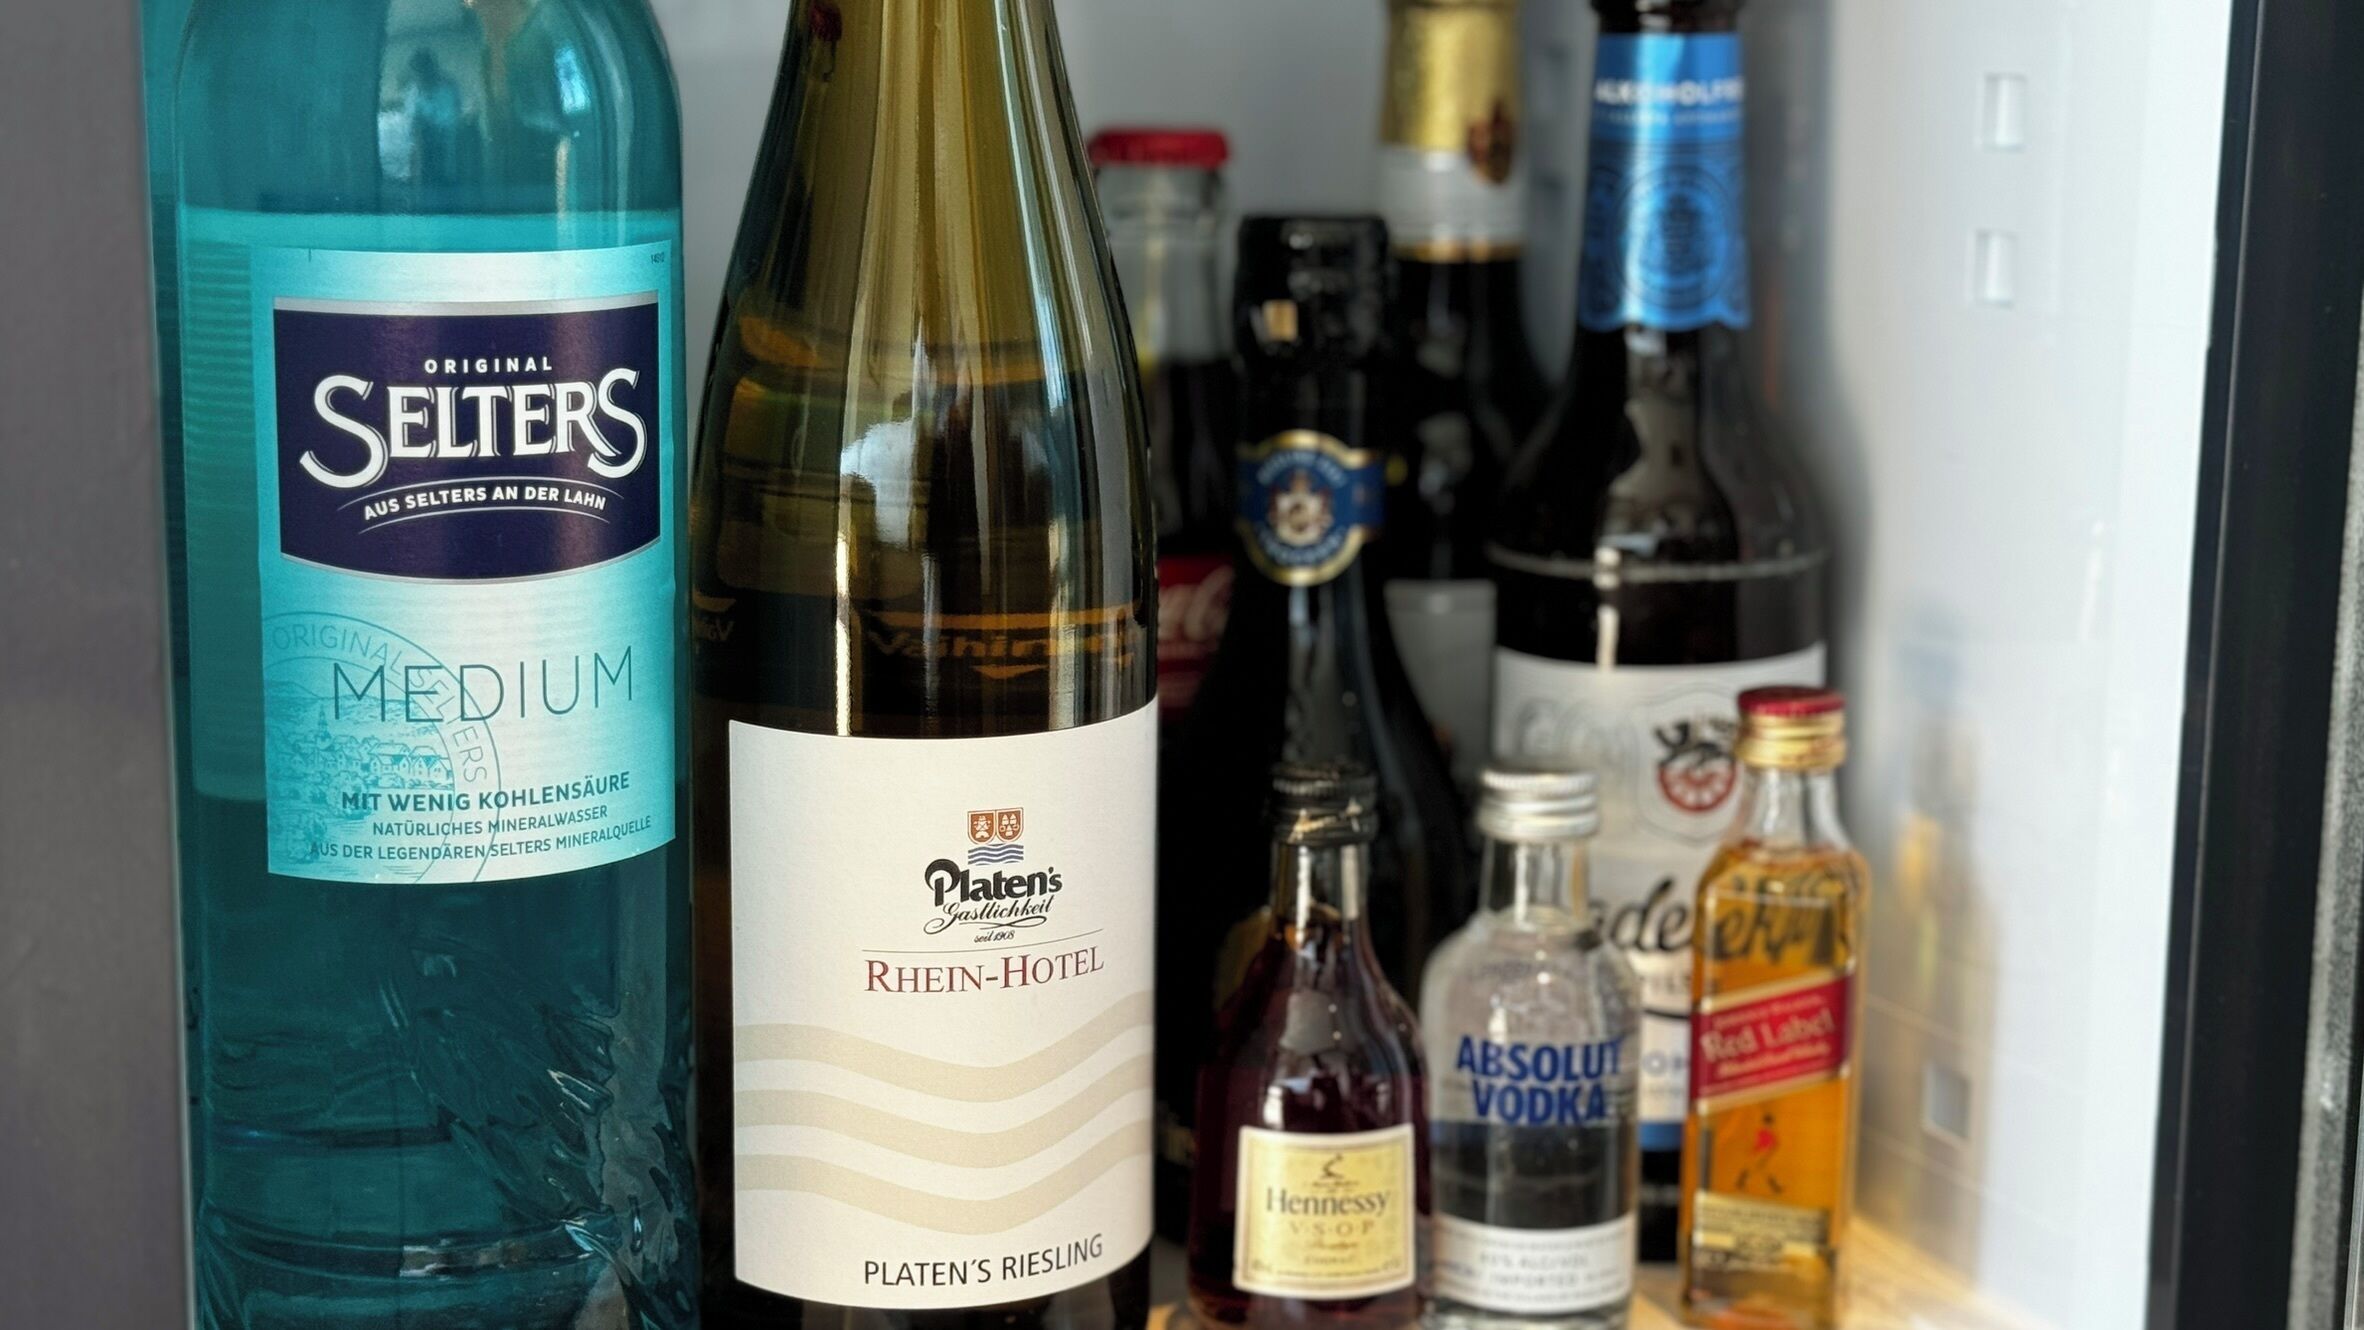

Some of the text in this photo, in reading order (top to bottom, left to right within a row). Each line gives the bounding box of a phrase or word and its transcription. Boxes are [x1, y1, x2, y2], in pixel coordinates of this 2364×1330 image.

[424, 356, 552, 374] ORIGINAL
[299, 367, 647, 488] SELTERS
[363, 486, 607, 521] AUS SELTERS AN DER LAHN
[272, 624, 404, 676] ORIGINAL
[333, 645, 633, 723] MEDIUM
[341, 771, 631, 812] MIT WENIG KOHLENSÄURE
[309, 815, 652, 860] AUS DER LEGENDÄREN SELTERS MINERALQUELLE
[373, 805, 608, 837] NATÜRLICHES MINERALWASSER
[924, 858, 1063, 907] Platen's
[923, 895, 1055, 935] Gastlichkeit
[1456, 1033, 1624, 1084] ABSOLUT
[1700, 1025, 1758, 1064] Red
[1759, 1007, 1835, 1049] Label
[1471, 1079, 1609, 1127] VODKA
[1266, 1187, 1391, 1218] Hennessy
[1002, 1232, 1102, 1281] RIESLING
